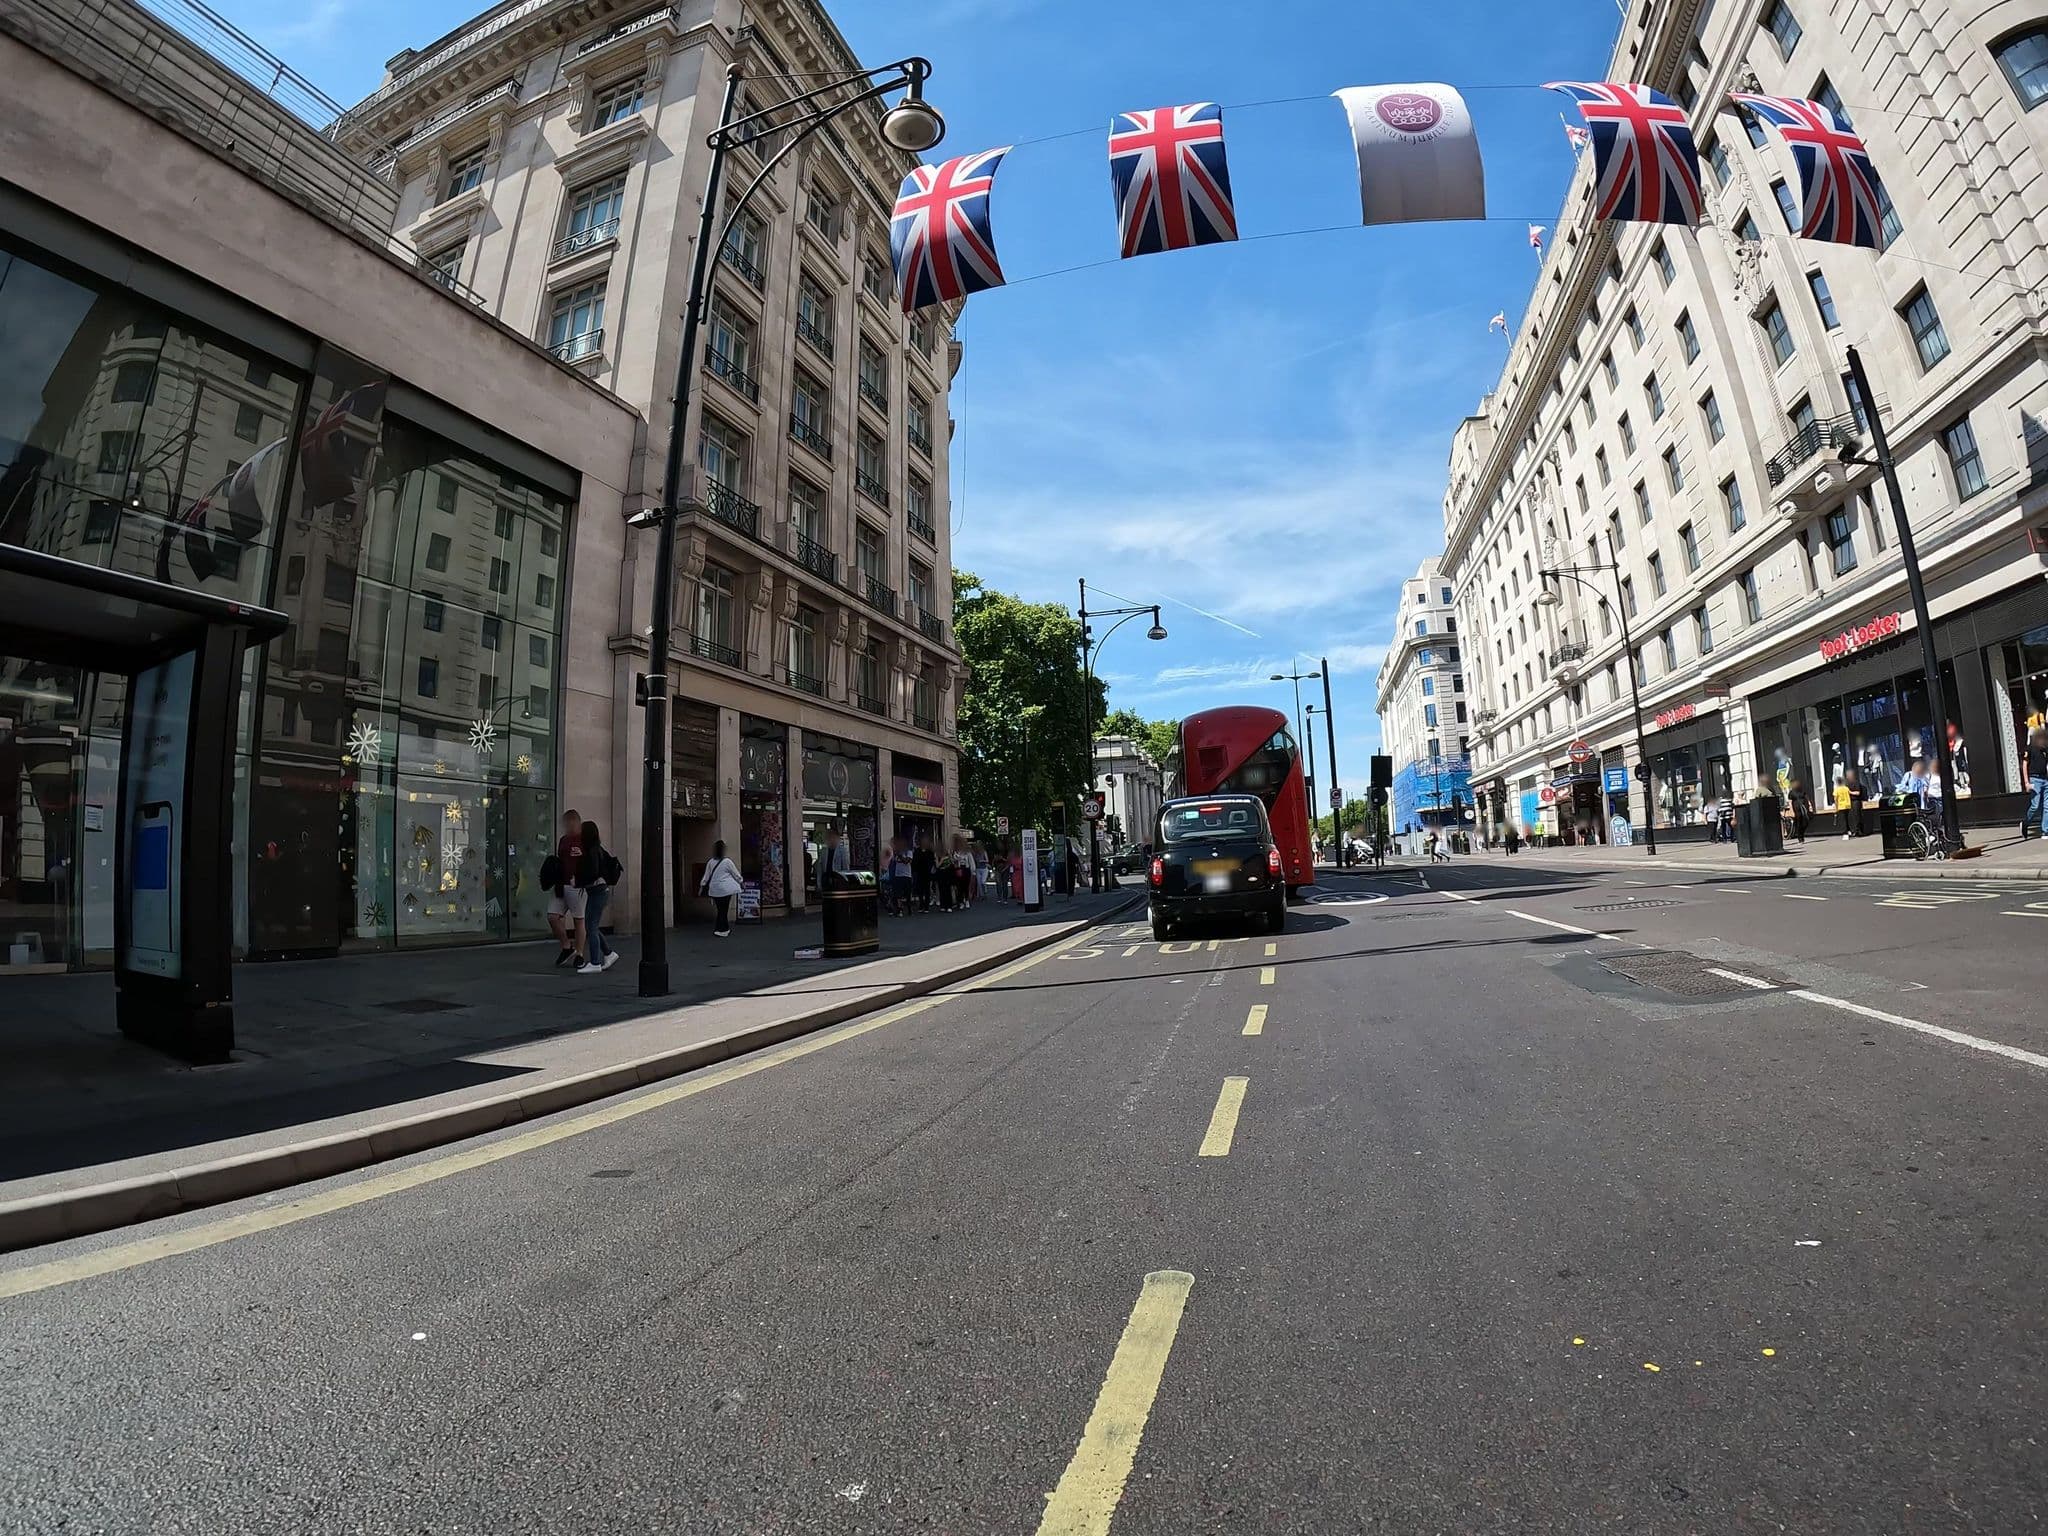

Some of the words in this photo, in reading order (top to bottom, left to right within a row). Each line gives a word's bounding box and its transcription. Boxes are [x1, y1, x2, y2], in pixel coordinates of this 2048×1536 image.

[1820, 632, 1849, 660] Foot
[1851, 612, 1901, 647] Locker
[908, 782, 932, 802] Candy
[1085, 805, 1099, 813] 20
